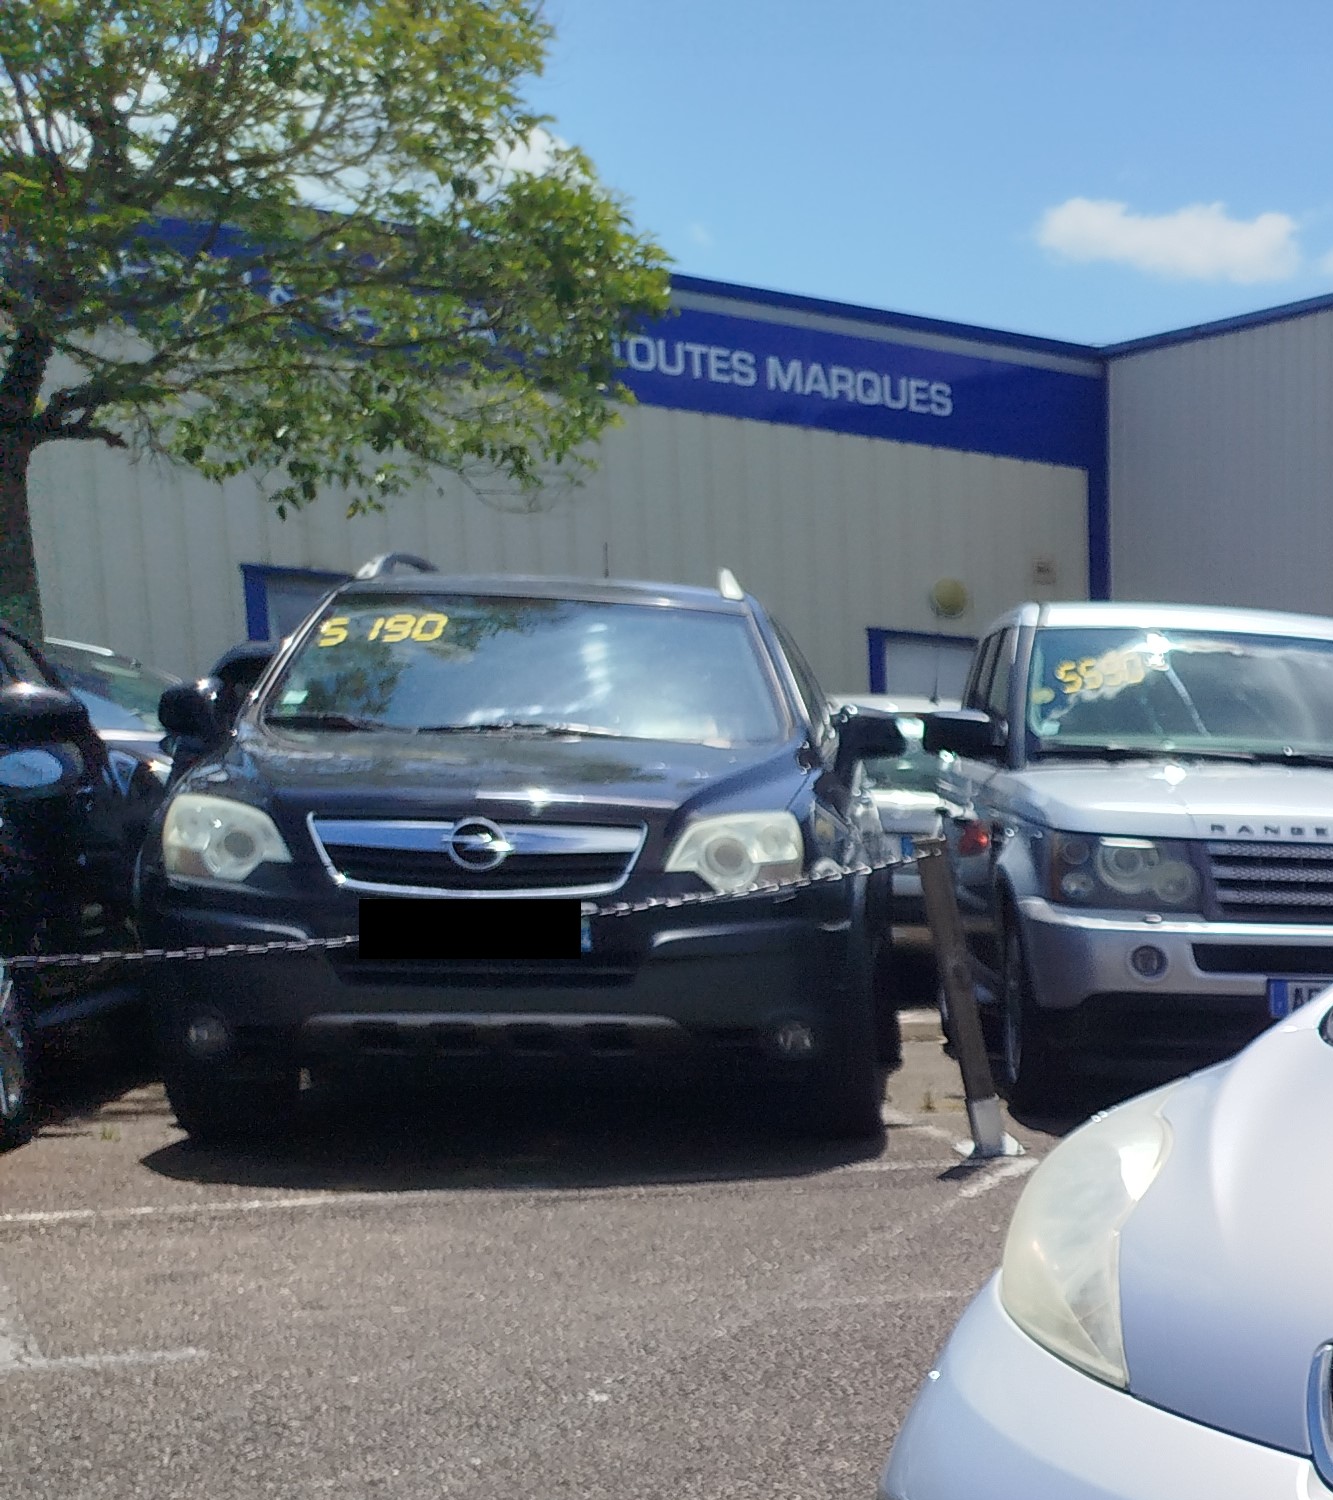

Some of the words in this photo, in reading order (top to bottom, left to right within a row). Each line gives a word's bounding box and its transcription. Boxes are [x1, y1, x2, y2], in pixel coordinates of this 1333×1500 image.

[765, 356, 954, 417] MARQUES
[367, 612, 450, 643] 190
[1210, 823, 1329, 838] RANGE
